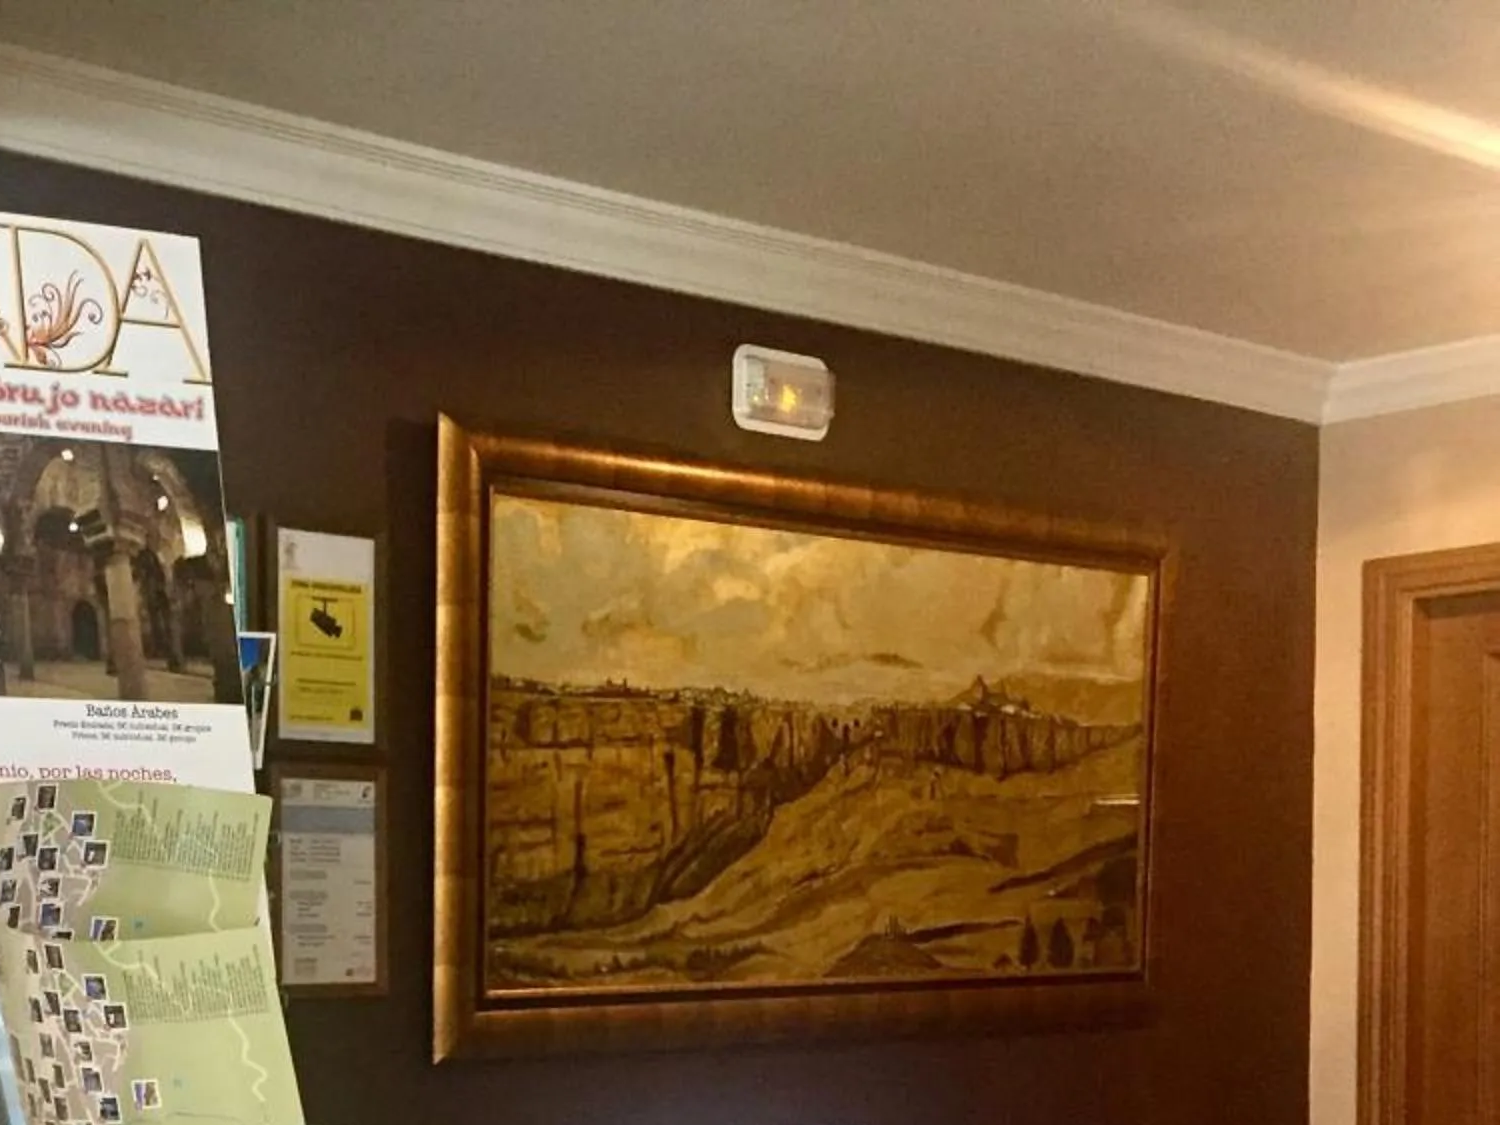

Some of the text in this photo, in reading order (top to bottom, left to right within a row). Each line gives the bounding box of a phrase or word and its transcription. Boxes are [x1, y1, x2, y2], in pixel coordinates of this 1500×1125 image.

[38, 766, 73, 781] por
[76, 764, 103, 780] las
[107, 765, 178, 783] noches,
